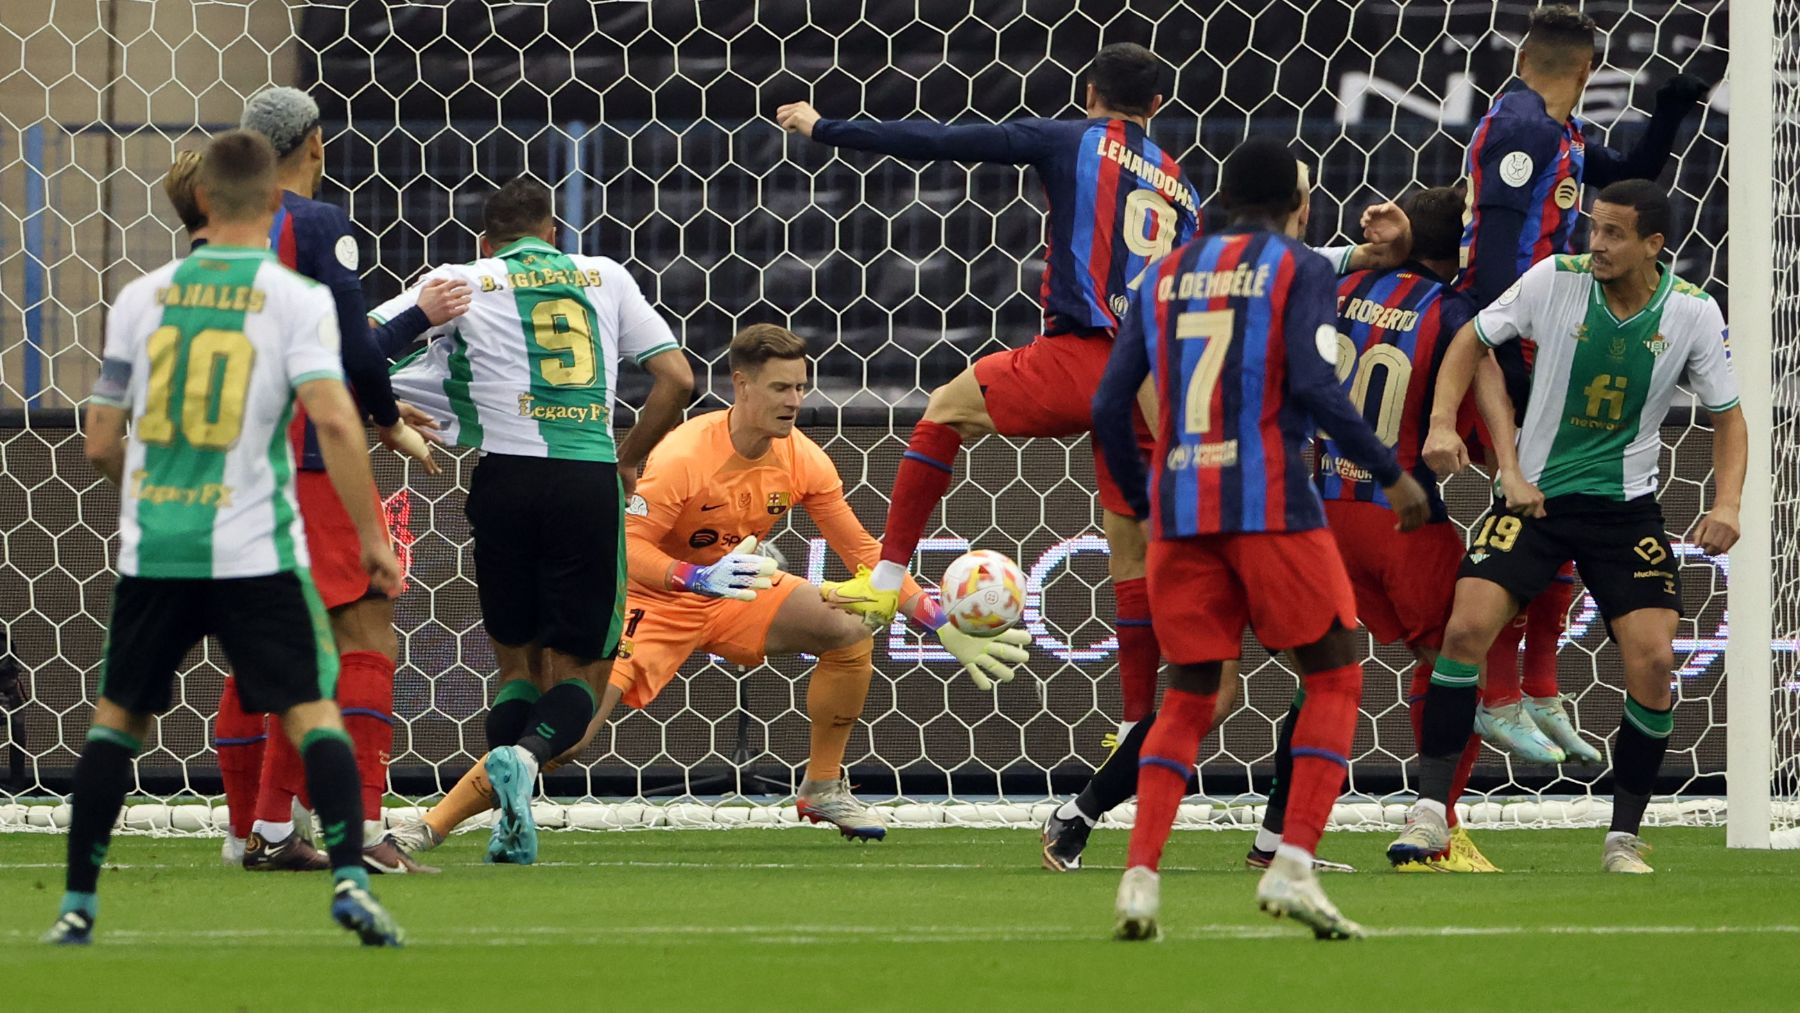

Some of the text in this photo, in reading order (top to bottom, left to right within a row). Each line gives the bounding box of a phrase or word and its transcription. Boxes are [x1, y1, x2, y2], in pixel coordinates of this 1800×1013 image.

[1097, 136, 1199, 231] LEWANDOWS
[1123, 189, 1178, 290] 9
[480, 274, 504, 292] B.
[1178, 263, 1270, 299] DEMBÉLÉ
[1344, 297, 1419, 332] ROBERTO
[531, 298, 599, 388] 9
[137, 325, 257, 453] 10
[1175, 309, 1235, 434] 7
[1584, 374, 1628, 420] fi
[1474, 515, 1523, 552] 19
[625, 608, 645, 638] 1
